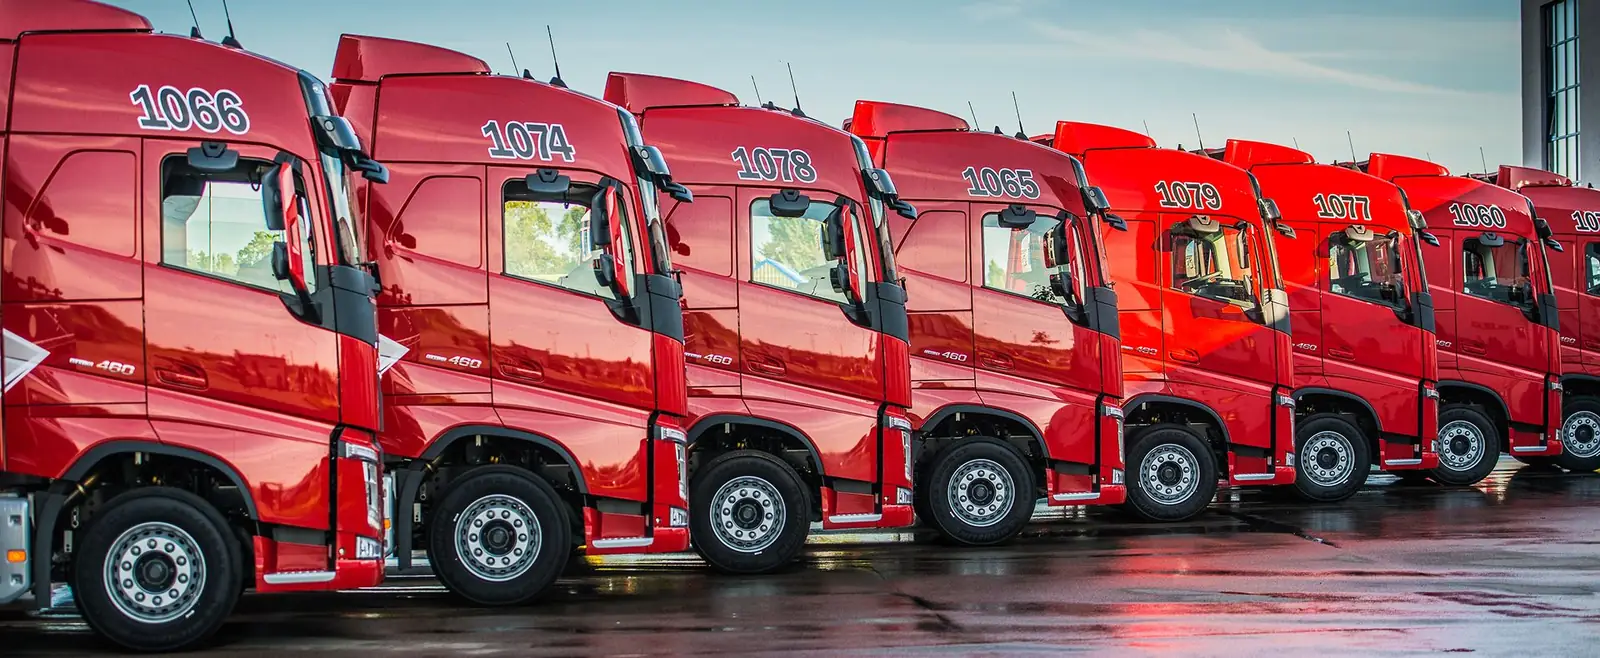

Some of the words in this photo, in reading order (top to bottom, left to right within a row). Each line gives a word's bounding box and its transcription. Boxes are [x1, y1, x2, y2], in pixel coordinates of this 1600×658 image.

[129, 85, 250, 135] 1066
[481, 120, 576, 162] 1074
[731, 146, 817, 183] 1078
[962, 166, 1040, 199] 1065
[1154, 180, 1222, 210] 1079
[1312, 193, 1372, 221] 1077
[1448, 203, 1507, 229] 1060
[1571, 210, 1600, 232] 10
[96, 360, 135, 375] 460
[448, 355, 482, 369] 460
[703, 353, 733, 365] 460
[941, 351, 967, 362] 460
